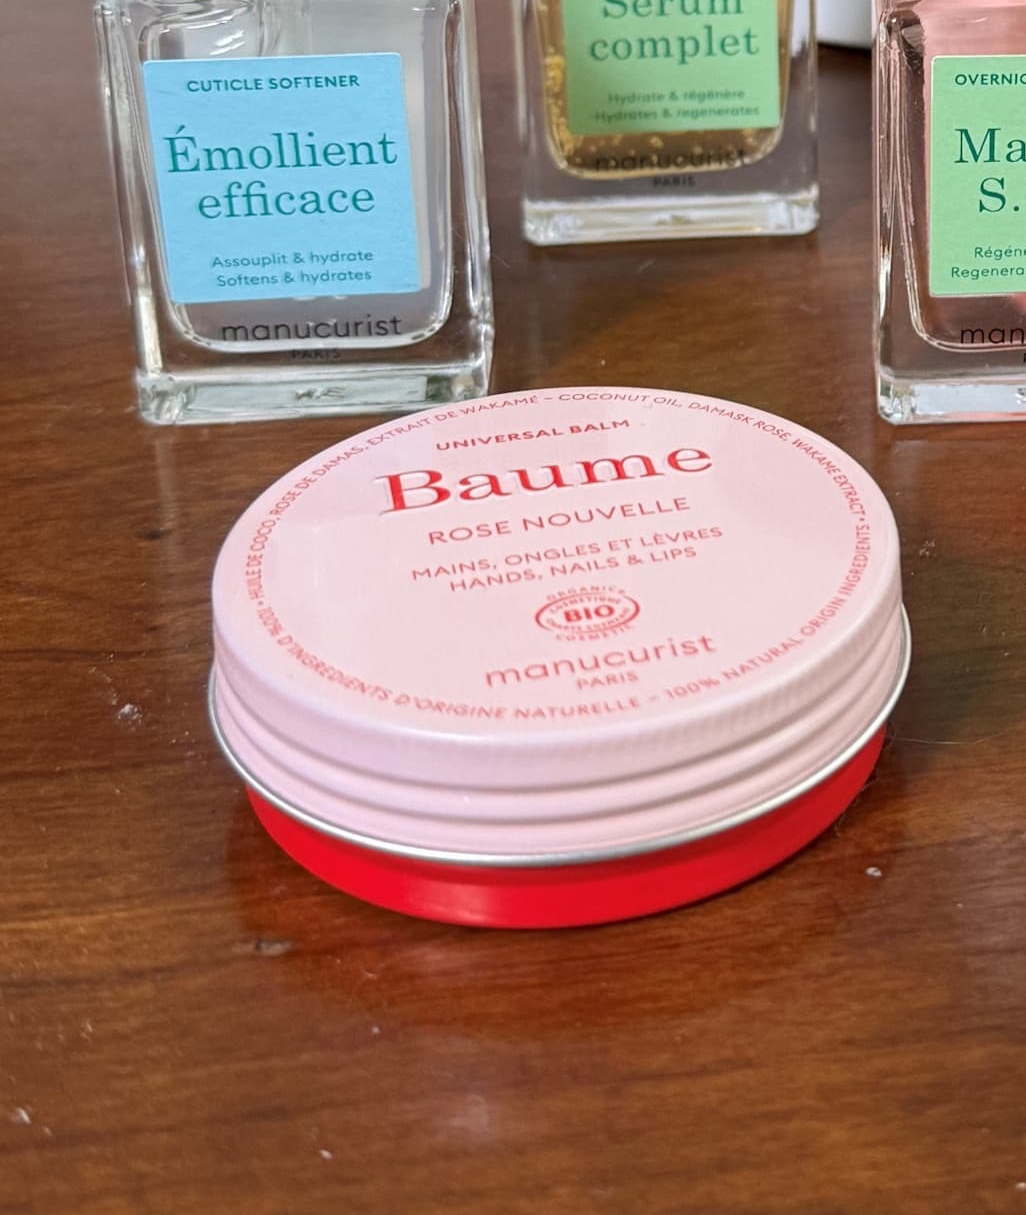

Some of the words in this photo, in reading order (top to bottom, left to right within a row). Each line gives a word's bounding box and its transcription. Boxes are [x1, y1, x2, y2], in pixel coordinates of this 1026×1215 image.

[589, 25, 759, 65] complet
[187, 78, 263, 92] CUTICLE
[269, 75, 360, 89] SOFTENER
[608, 92, 665, 106] Hydrate
[668, 90, 678, 101] &
[595, 109, 658, 124] Hydrates
[662, 107, 672, 118] &
[164, 125, 398, 174] Émollient
[199, 181, 375, 219] efficace
[211, 251, 288, 268] Assouplit
[294, 251, 305, 264] &
[310, 249, 373, 266] hydrate
[216, 273, 278, 287] Softens
[283, 271, 295, 284] &
[300, 268, 372, 285] hydrates
[221, 314, 402, 341] manucurist
[276, 488, 300, 514] ROSE
[300, 474, 317, 489] DE
[368, 418, 431, 446] EXTRAIT
[434, 410, 458, 422] DE
[558, 392, 650, 402] COCONUT
[688, 401, 753, 425] DAMASK
[792, 438, 840, 476] WAKAME
[832, 471, 867, 516] EXTRACT
[436, 427, 563, 451] UNIVERSAL
[569, 419, 629, 435] BALM
[376, 447, 713, 515] Baume
[428, 520, 512, 546] ROSE
[523, 497, 691, 531] NOUVELLE
[412, 558, 497, 581] MAINS,
[504, 542, 601, 567] ONGLES
[608, 537, 633, 551] ET
[641, 527, 723, 548] LÈVRES
[450, 568, 543, 592] HANDS,
[550, 556, 620, 577] NAILS
[628, 554, 643, 566] &
[649, 546, 697, 563] LIPS
[514, 697, 641, 720] NATURELLE
[666, 676, 721, 699] 100%
[723, 637, 804, 680] NATURAL
[800, 596, 846, 638] ORIGIN
[838, 524, 871, 597] INGREDIENTS
[564, 604, 615, 623] BIO
[485, 635, 717, 687] manucurist
[576, 670, 639, 690] PARIS
